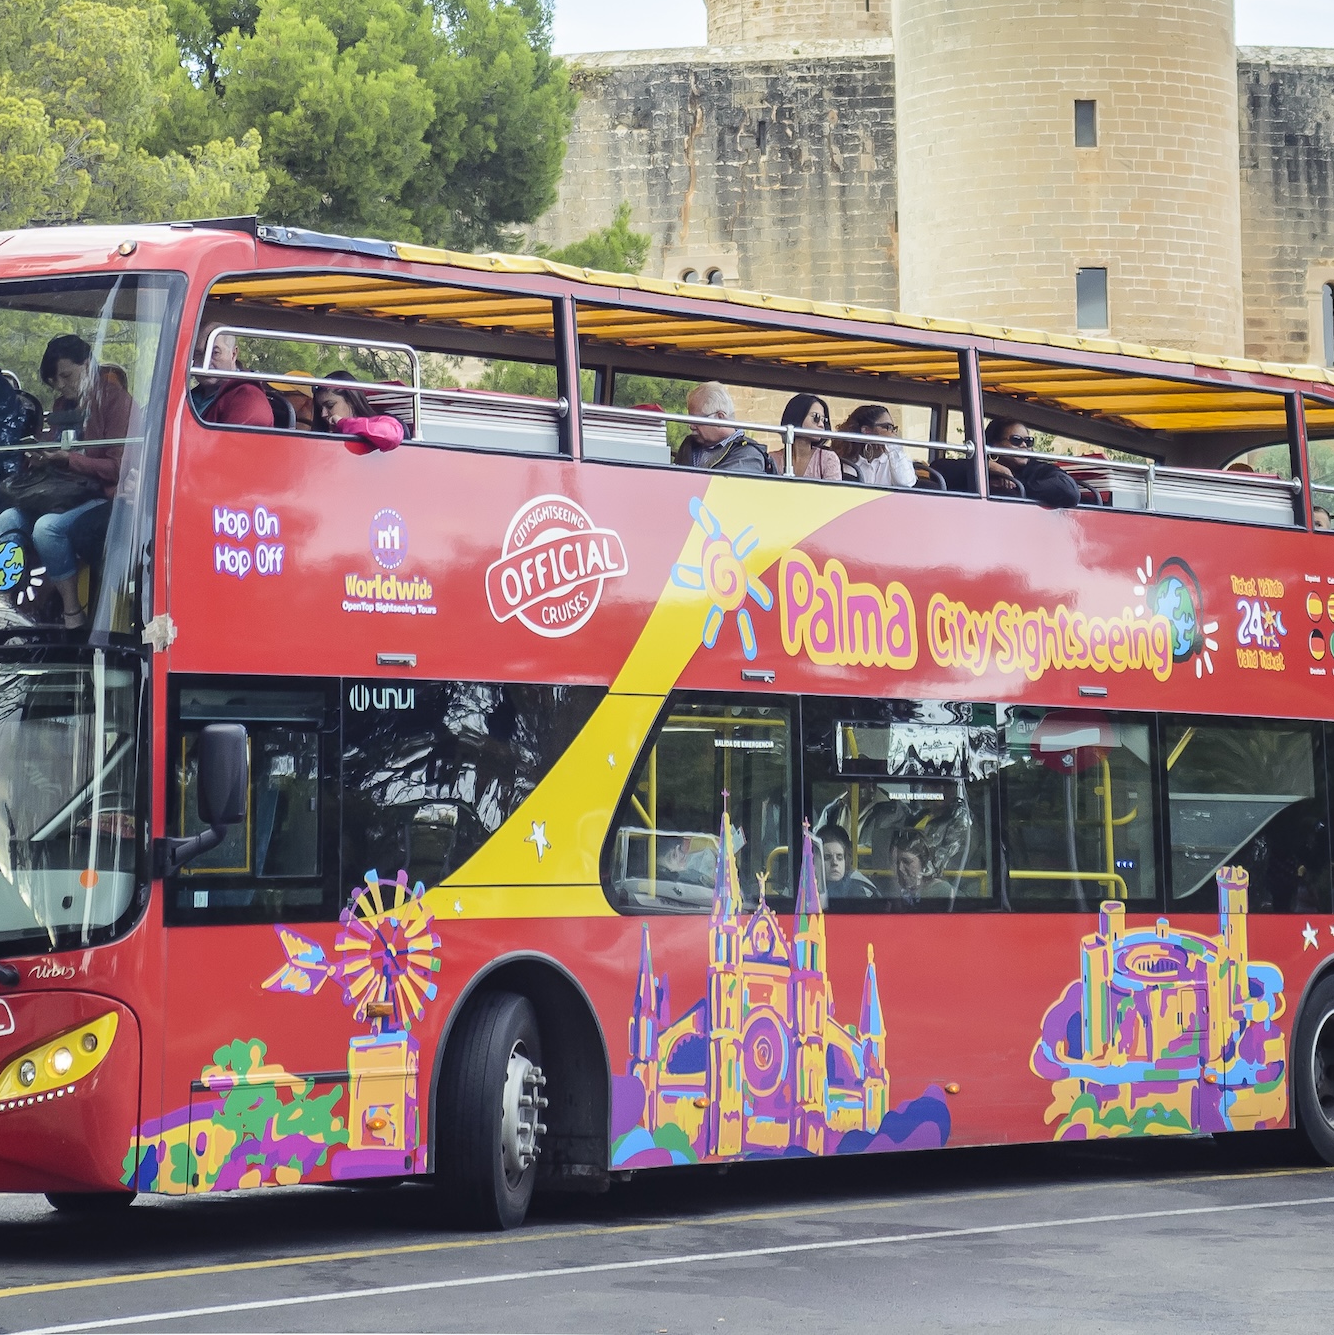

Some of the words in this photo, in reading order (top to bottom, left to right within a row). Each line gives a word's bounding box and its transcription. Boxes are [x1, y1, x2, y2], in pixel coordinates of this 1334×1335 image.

[213, 507, 250, 539] Hop
[253, 506, 279, 537] On
[514, 505, 584, 547] CITYSIGHTSEEING
[214, 545, 252, 578] Hop
[255, 543, 284, 574] Off
[501, 537, 619, 606] OFFICIAL
[345, 574, 433, 601] Worldwide
[1230, 574, 1258, 597] Ticket
[375, 603, 416, 615] Sightseeing
[417, 605, 436, 614] Tours
[542, 590, 590, 625] CRUISES
[779, 552, 915, 668] Palma
[1237, 599, 1264, 645] 24
[1236, 648, 1258, 669] Valid
[1259, 649, 1286, 672] Ticket
[714, 739, 733, 748] SALIDA
[733, 740, 740, 748] DE
[741, 740, 774, 749] EMERGENCIA
[889, 792, 906, 800] SALIDA
[914, 793, 944, 801] EMERGENCIA
